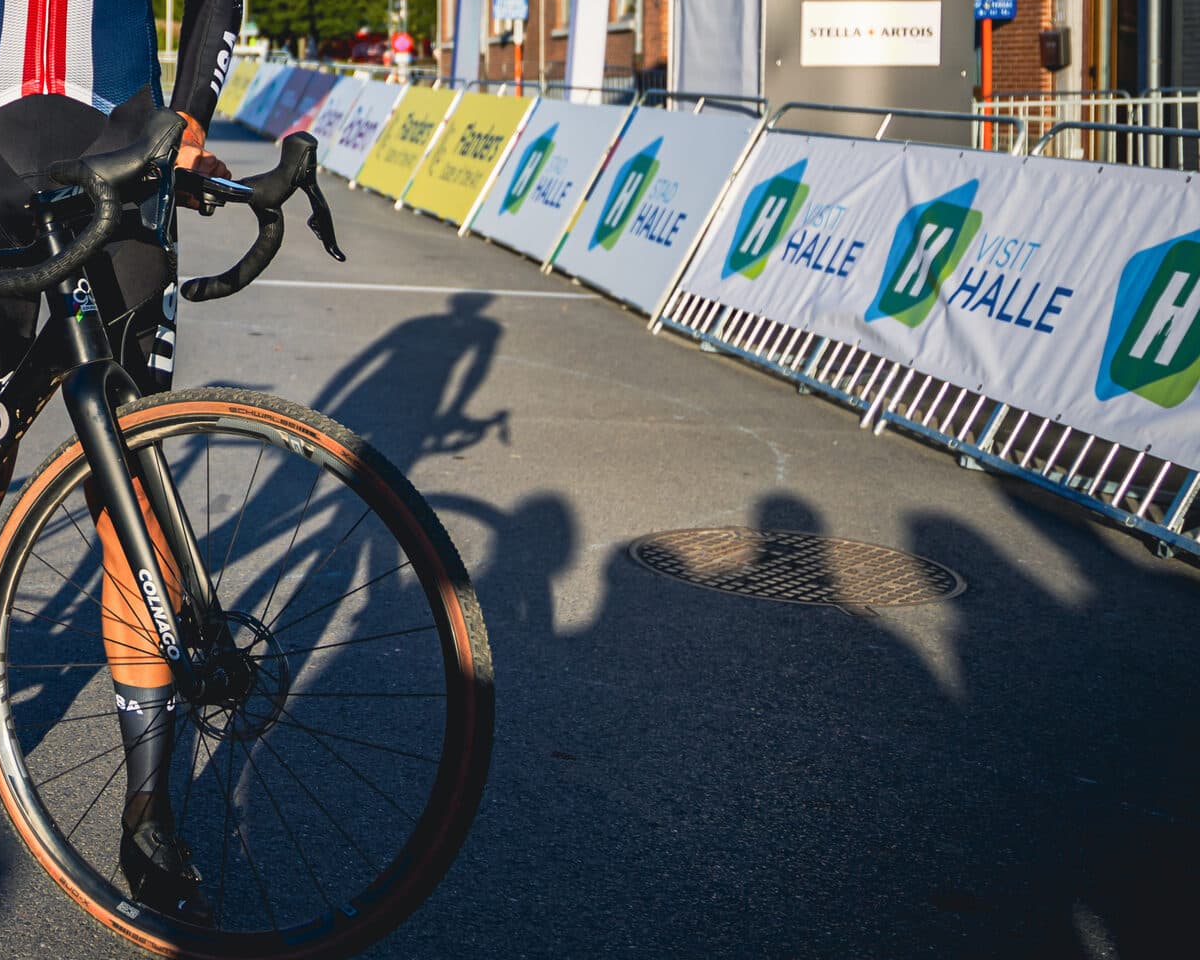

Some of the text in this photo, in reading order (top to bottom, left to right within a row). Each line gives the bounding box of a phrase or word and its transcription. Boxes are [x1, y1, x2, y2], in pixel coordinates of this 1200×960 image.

[809, 25, 934, 38] STELLA ARTOIS
[530, 180, 573, 209] HALLE
[803, 201, 846, 230] VISIT
[630, 203, 687, 247] HALLE
[782, 229, 865, 278] HALLE
[975, 230, 1042, 273] VISIT
[948, 267, 1075, 335] HALLE
[138, 568, 180, 660] COLNAGO
